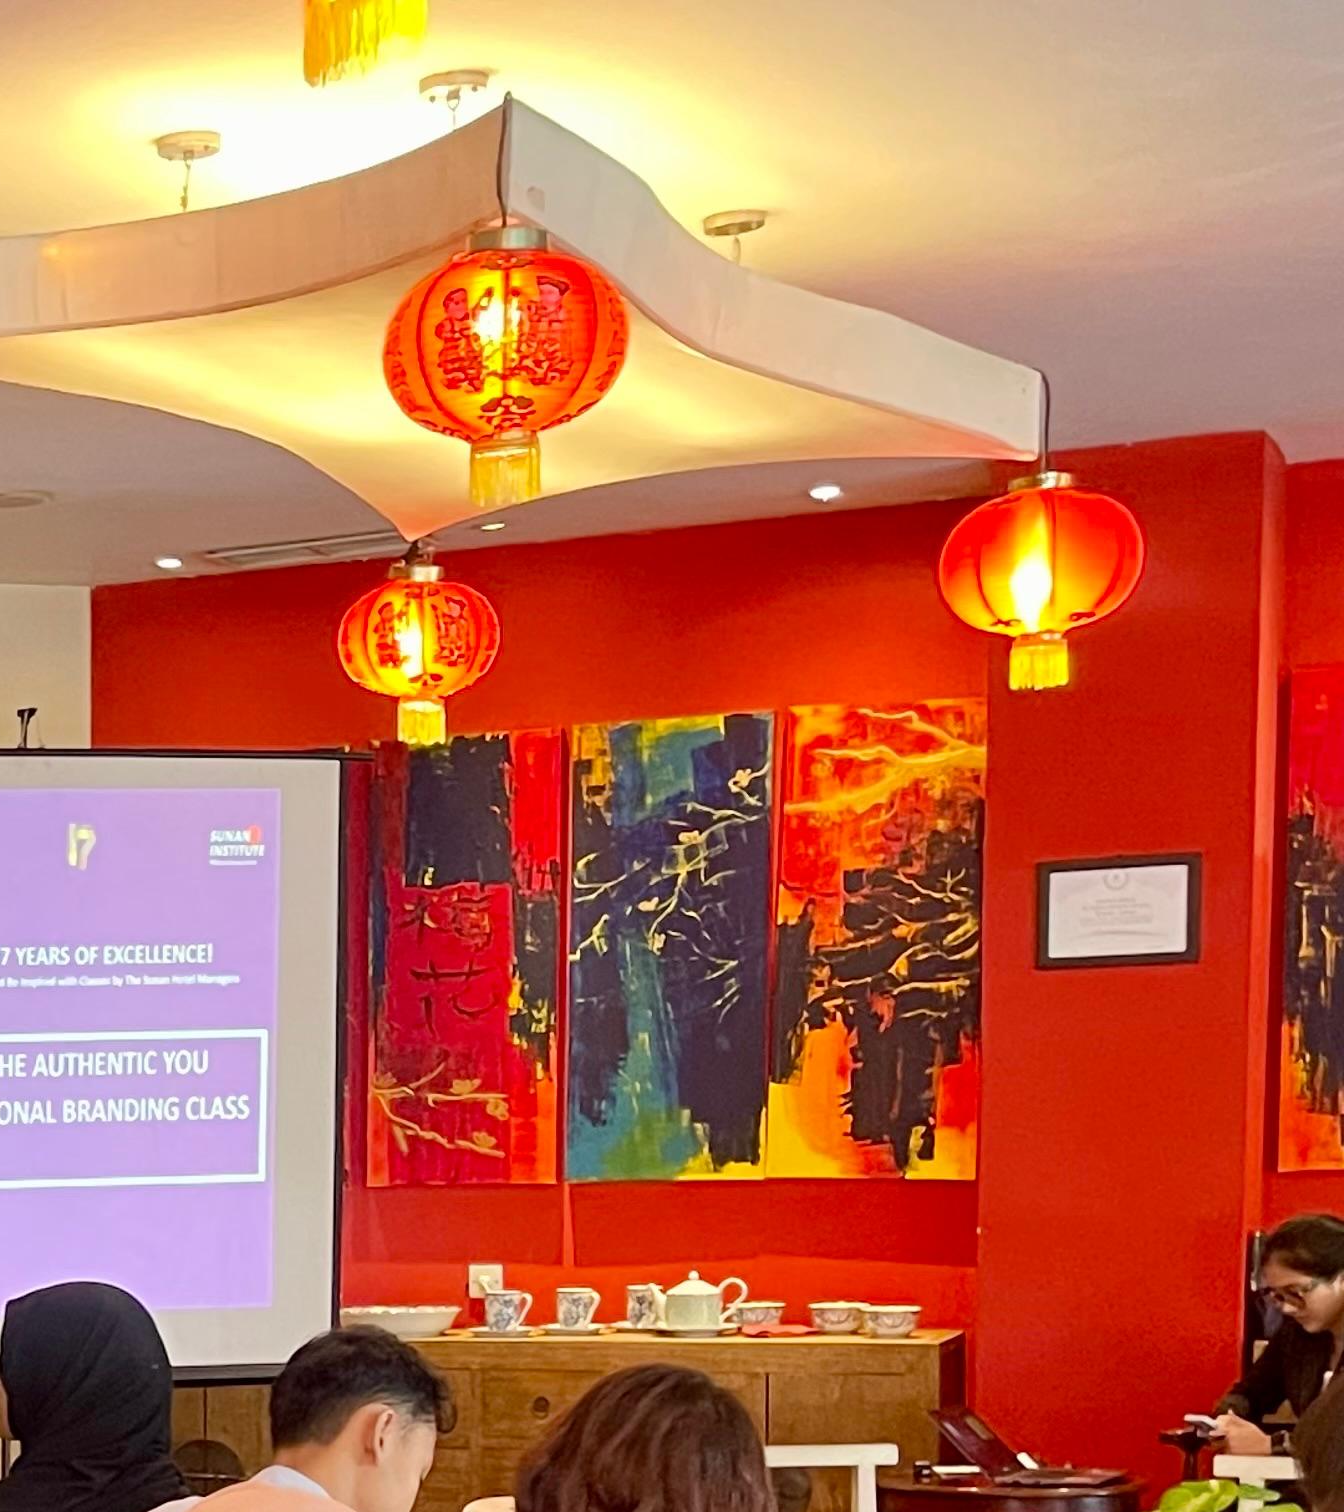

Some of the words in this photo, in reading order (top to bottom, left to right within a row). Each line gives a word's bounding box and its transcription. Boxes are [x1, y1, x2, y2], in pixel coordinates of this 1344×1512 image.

[209, 844, 265, 857] INSTITUTE
[14, 946, 71, 966] YEARS
[74, 945, 99, 965] OF
[102, 942, 214, 965] EXCELLENCE!
[31, 1051, 159, 1077] AUTHENTIC
[162, 1049, 209, 1075] YOU
[63, 1097, 180, 1123] BRANDING
[185, 1094, 250, 1120] CLASS
